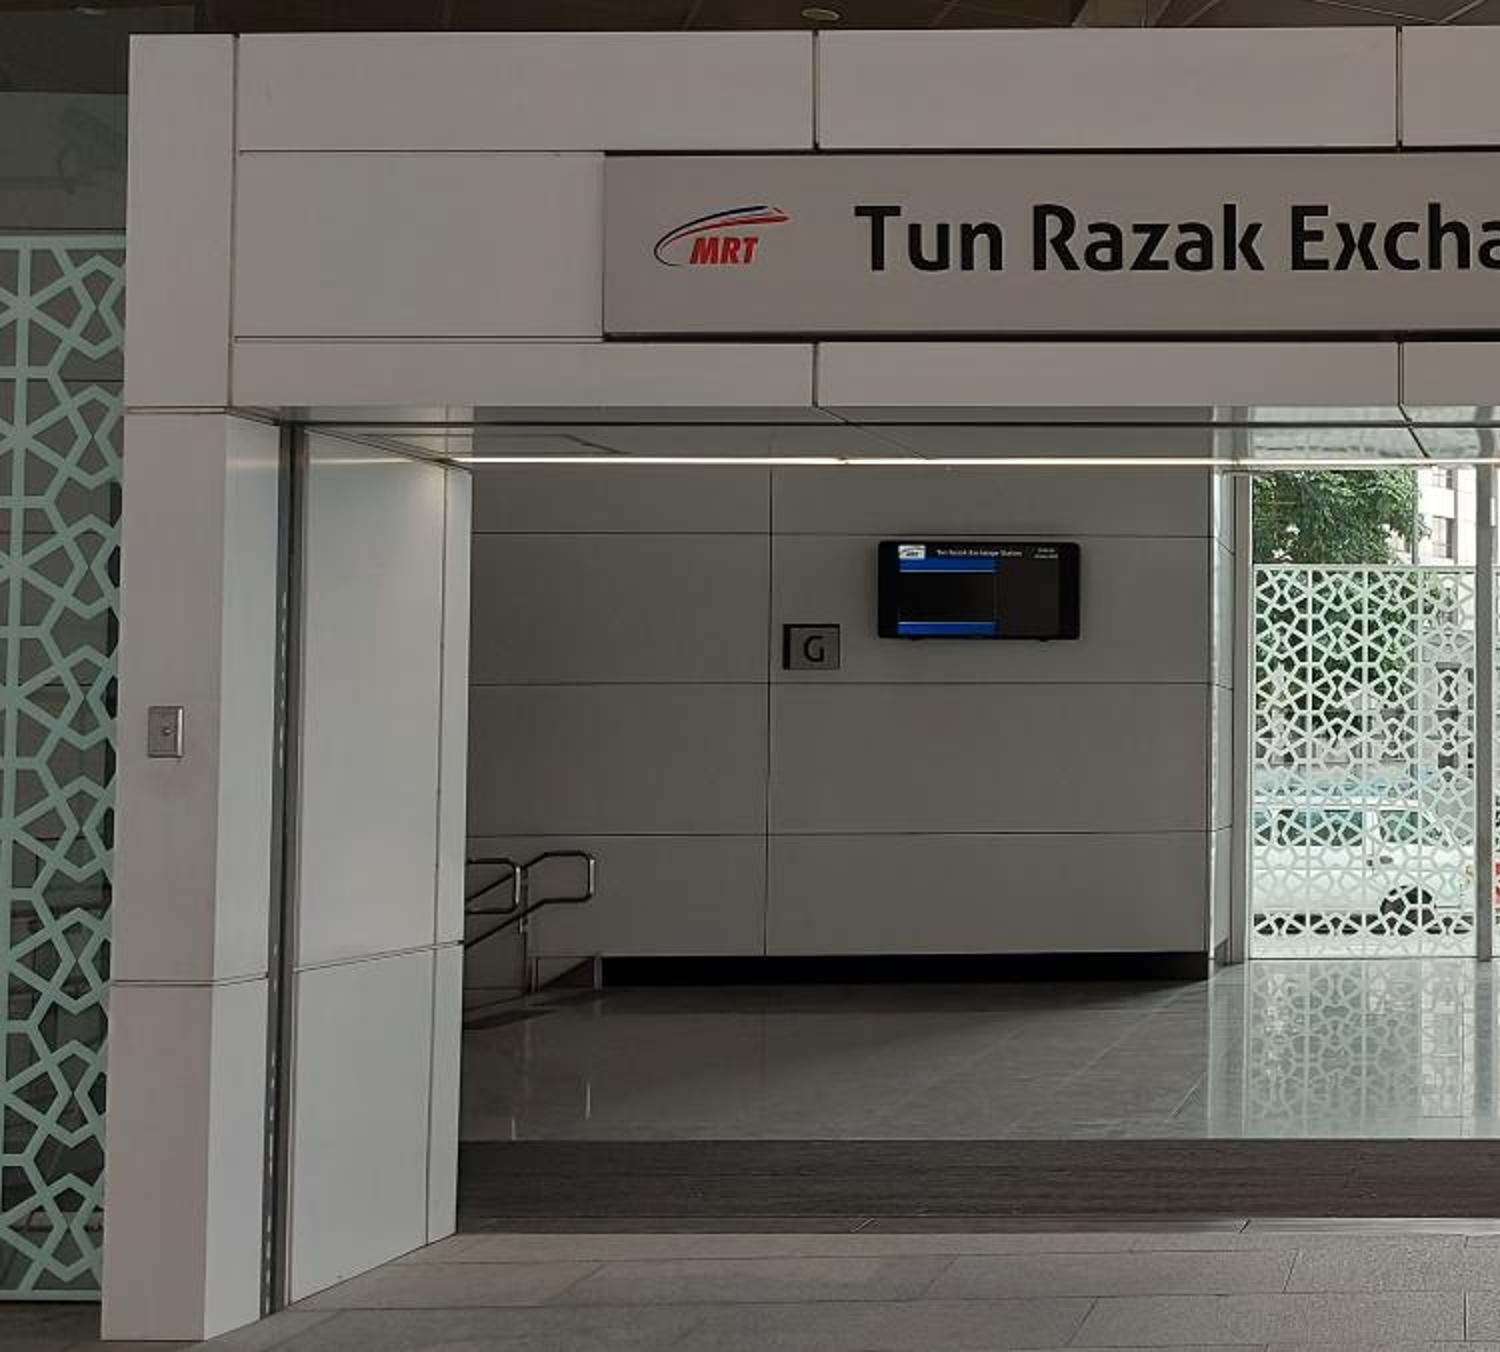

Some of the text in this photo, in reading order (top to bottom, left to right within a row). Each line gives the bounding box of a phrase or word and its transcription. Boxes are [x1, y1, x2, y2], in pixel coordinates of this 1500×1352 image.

[689, 237, 758, 265] MRT
[854, 204, 1003, 272] Tun
[1032, 203, 1265, 271] Razak
[804, 635, 825, 663] G
